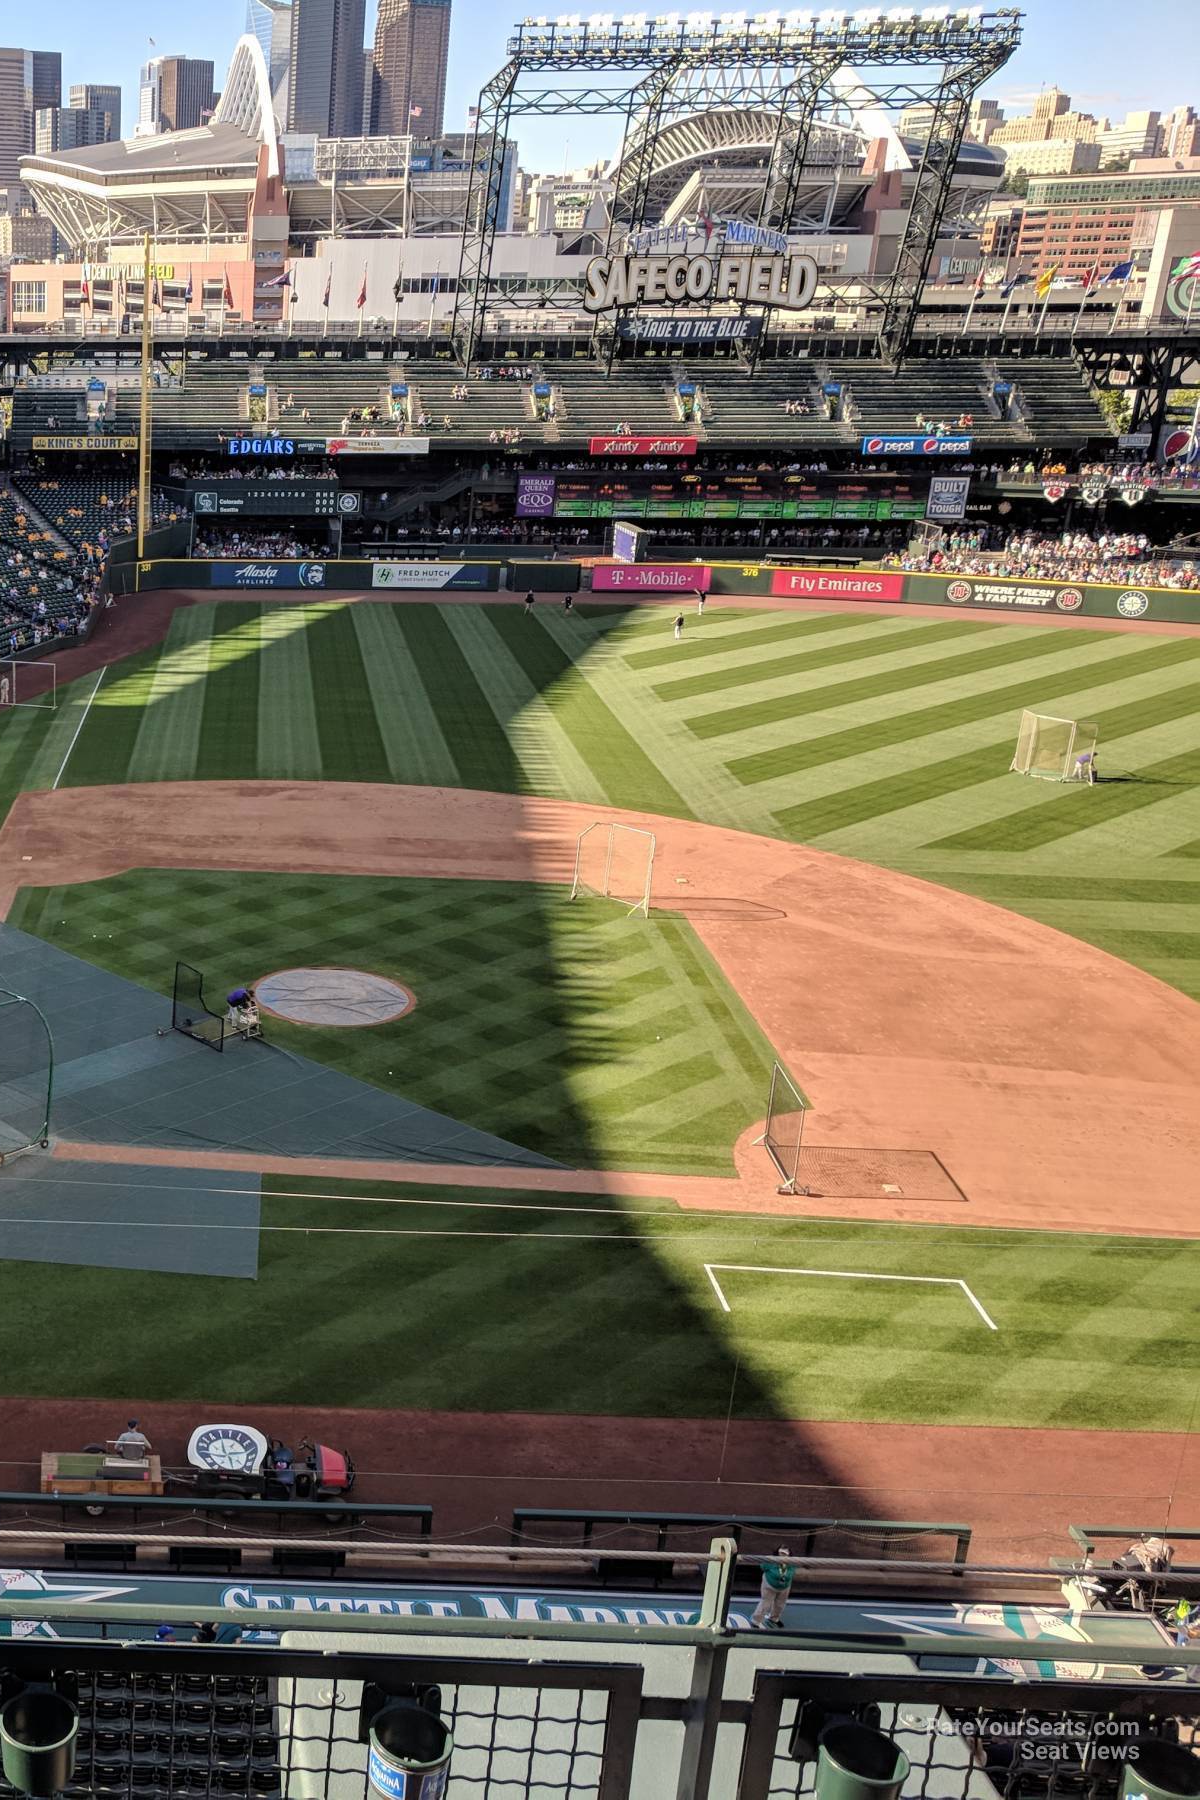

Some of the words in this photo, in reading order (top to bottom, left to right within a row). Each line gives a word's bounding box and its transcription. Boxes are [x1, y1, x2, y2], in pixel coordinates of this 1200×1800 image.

[626, 223, 688, 253] SEATTLE
[725, 220, 789, 251] MARINERS
[583, 254, 713, 314] SAFECO
[715, 254, 819, 311] FIELD
[643, 318, 673, 338] TRUE
[674, 320, 691, 337] TO
[692, 319, 716, 337] THE
[717, 318, 751, 337] BLUE
[47, 438, 83, 449] KING'S
[87, 438, 122, 449] COURT
[603, 441, 640, 453] xfinity
[649, 441, 685, 453] xfinity
[884, 441, 915, 453] pepsi
[939, 441, 970, 453] pepsi
[933, 481, 965, 493] BUILT
[1048, 487, 1061, 497] 42
[1087, 489, 1100, 498] 24
[1128, 490, 1137, 500] 11
[523, 494, 551, 507] EQC
[931, 504, 962, 513] TOUGH
[140, 563, 151, 572] 331
[235, 564, 279, 577] Alaska
[398, 569, 420, 577] FRED
[742, 568, 759, 577] 376
[790, 576, 815, 593] Fly
[817, 576, 883, 594] Emirates
[974, 584, 1016, 596] WHERE
[1016, 587, 1056, 599] FRESH
[974, 592, 984, 601] &
[984, 593, 1015, 604] FAST
[1015, 595, 1052, 606] MEET
[198, 1429, 252, 1448] SEATTLE
